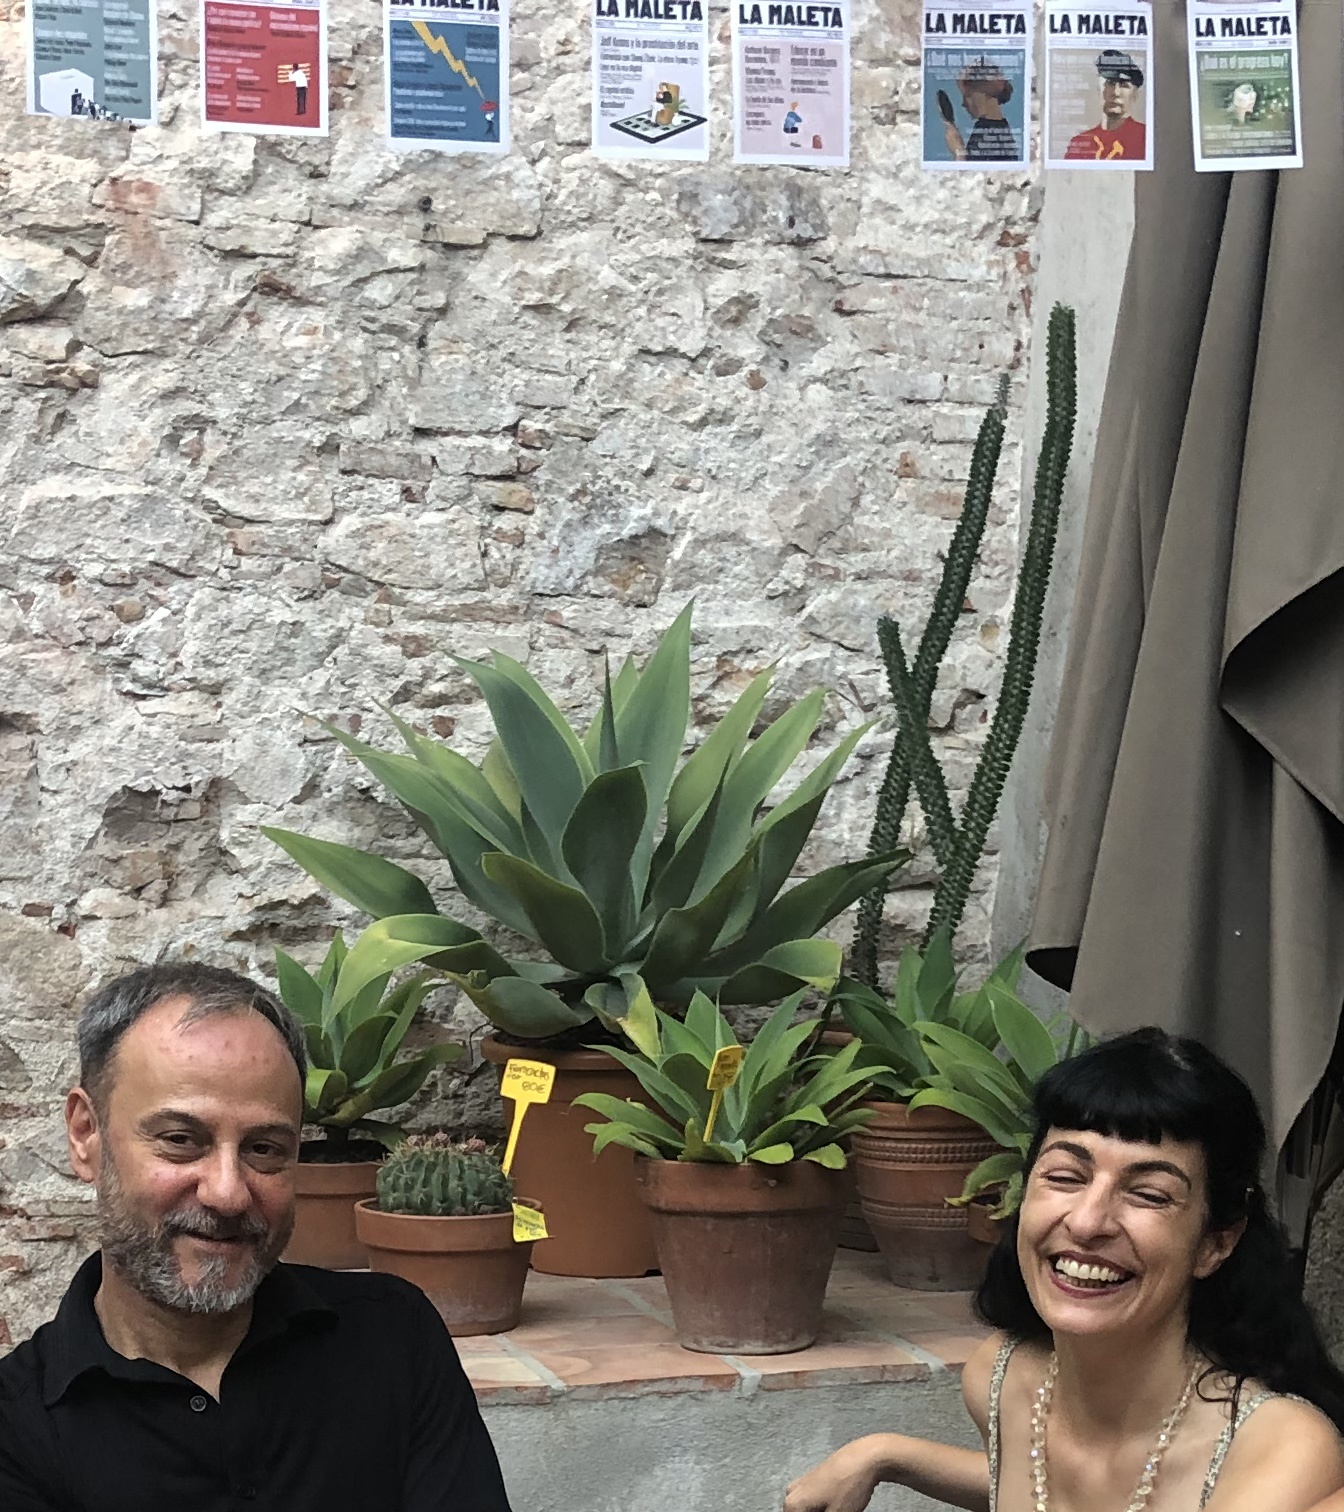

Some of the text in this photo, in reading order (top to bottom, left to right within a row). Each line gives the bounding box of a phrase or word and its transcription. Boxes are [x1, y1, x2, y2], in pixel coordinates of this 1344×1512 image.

[596, 0, 703, 21] LA MALETA
[739, 4, 843, 28] LA MALETA
[925, 13, 1026, 34] LA MALETA
[1049, 14, 1148, 36] LA MALETA
[1195, 15, 1292, 38] LA MALETA
